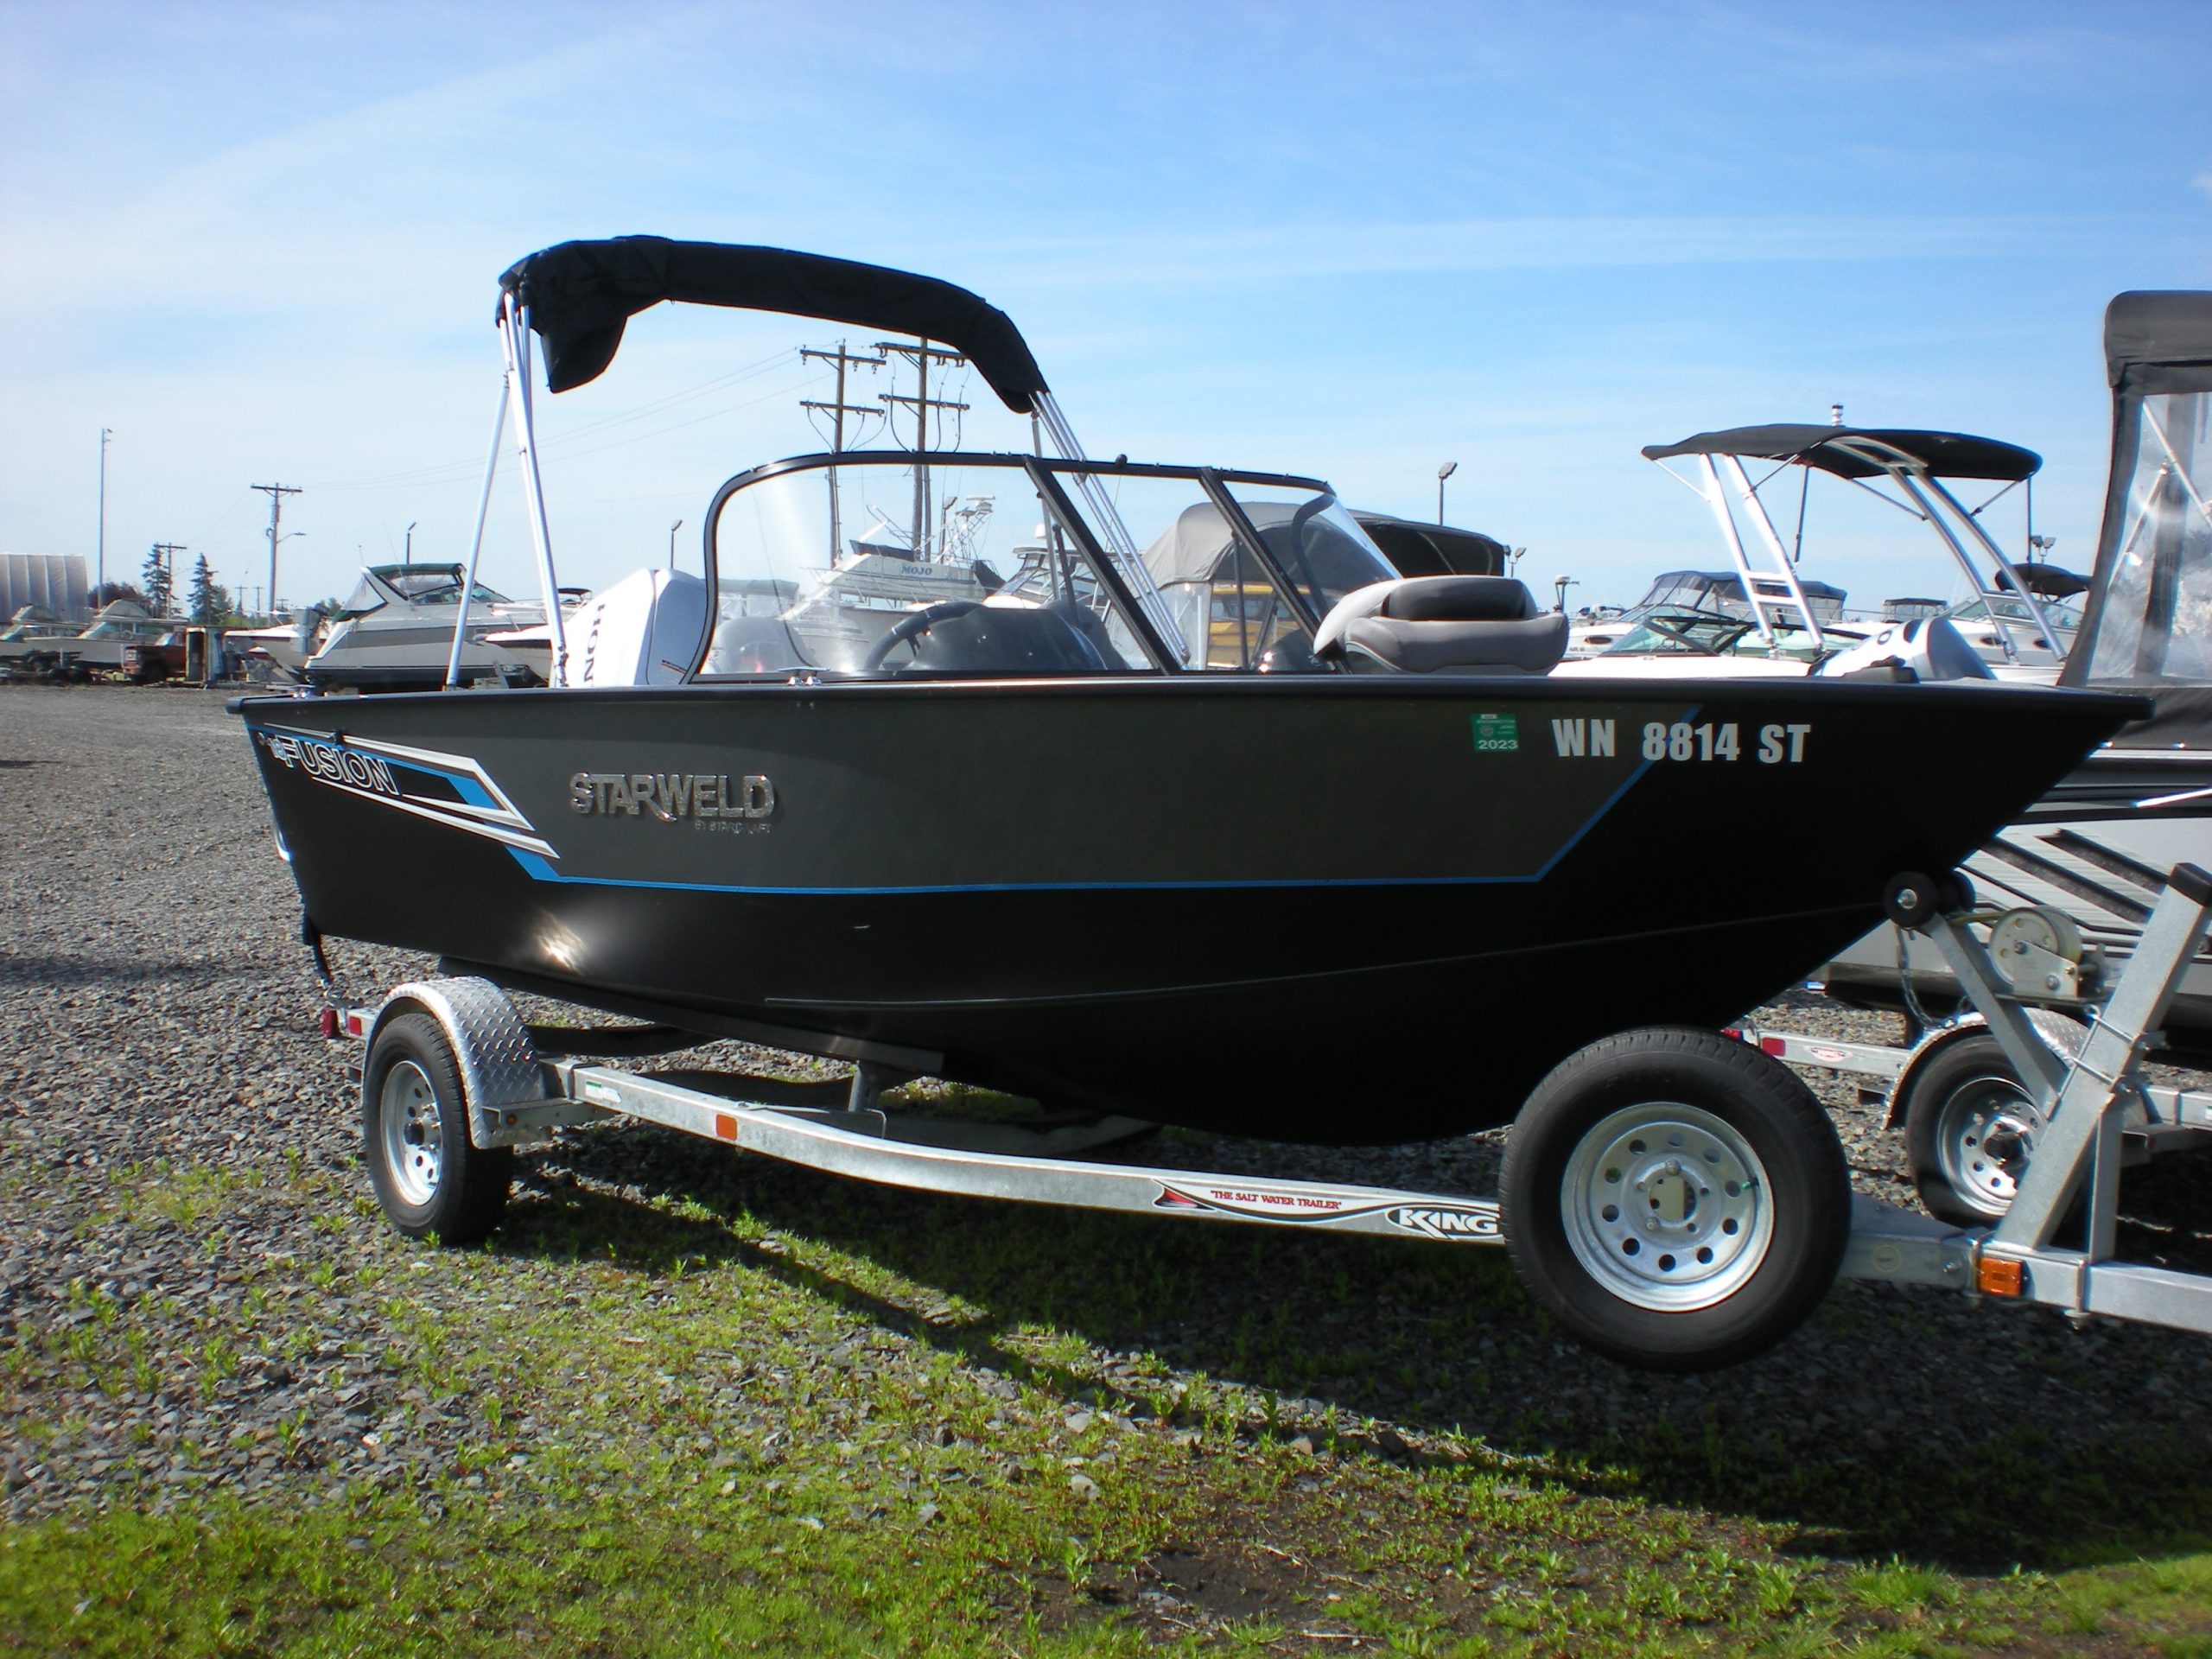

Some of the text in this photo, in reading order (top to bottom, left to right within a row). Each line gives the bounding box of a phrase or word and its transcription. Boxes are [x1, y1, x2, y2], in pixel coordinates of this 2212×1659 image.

[900, 565, 933, 576] MOJO
[584, 603, 606, 683] HON
[1478, 740, 1519, 750] 2023
[1552, 718, 1812, 764] WN 8814 ST
[275, 734, 400, 796] FUSION
[569, 772, 776, 821] STARWELD
[1236, 1192, 1258, 1202] SALT
[1262, 1195, 1294, 1205] WATER
[1399, 1209, 1498, 1240] KING
